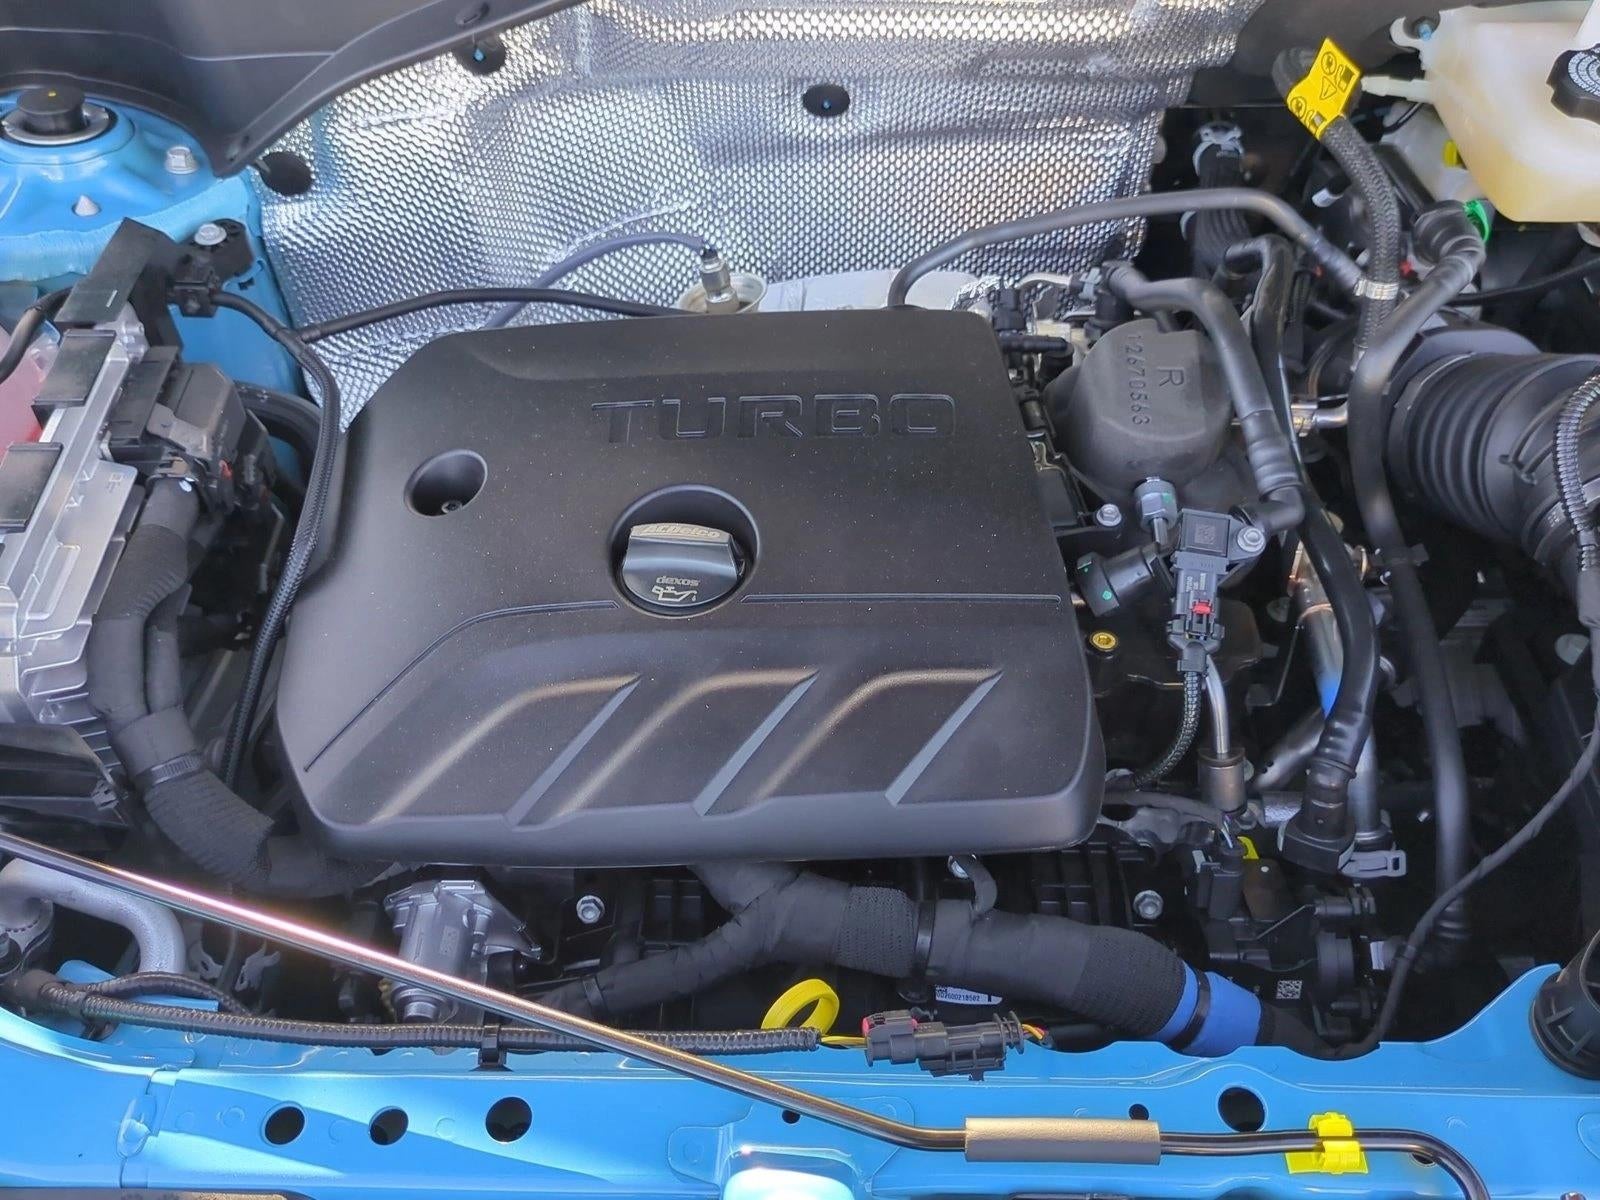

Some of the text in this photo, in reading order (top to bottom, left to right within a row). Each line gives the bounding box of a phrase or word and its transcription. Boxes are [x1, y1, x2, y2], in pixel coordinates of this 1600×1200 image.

[1157, 366, 1185, 388] R
[591, 393, 956, 447] TURBO
[656, 575, 700, 587] dexos
